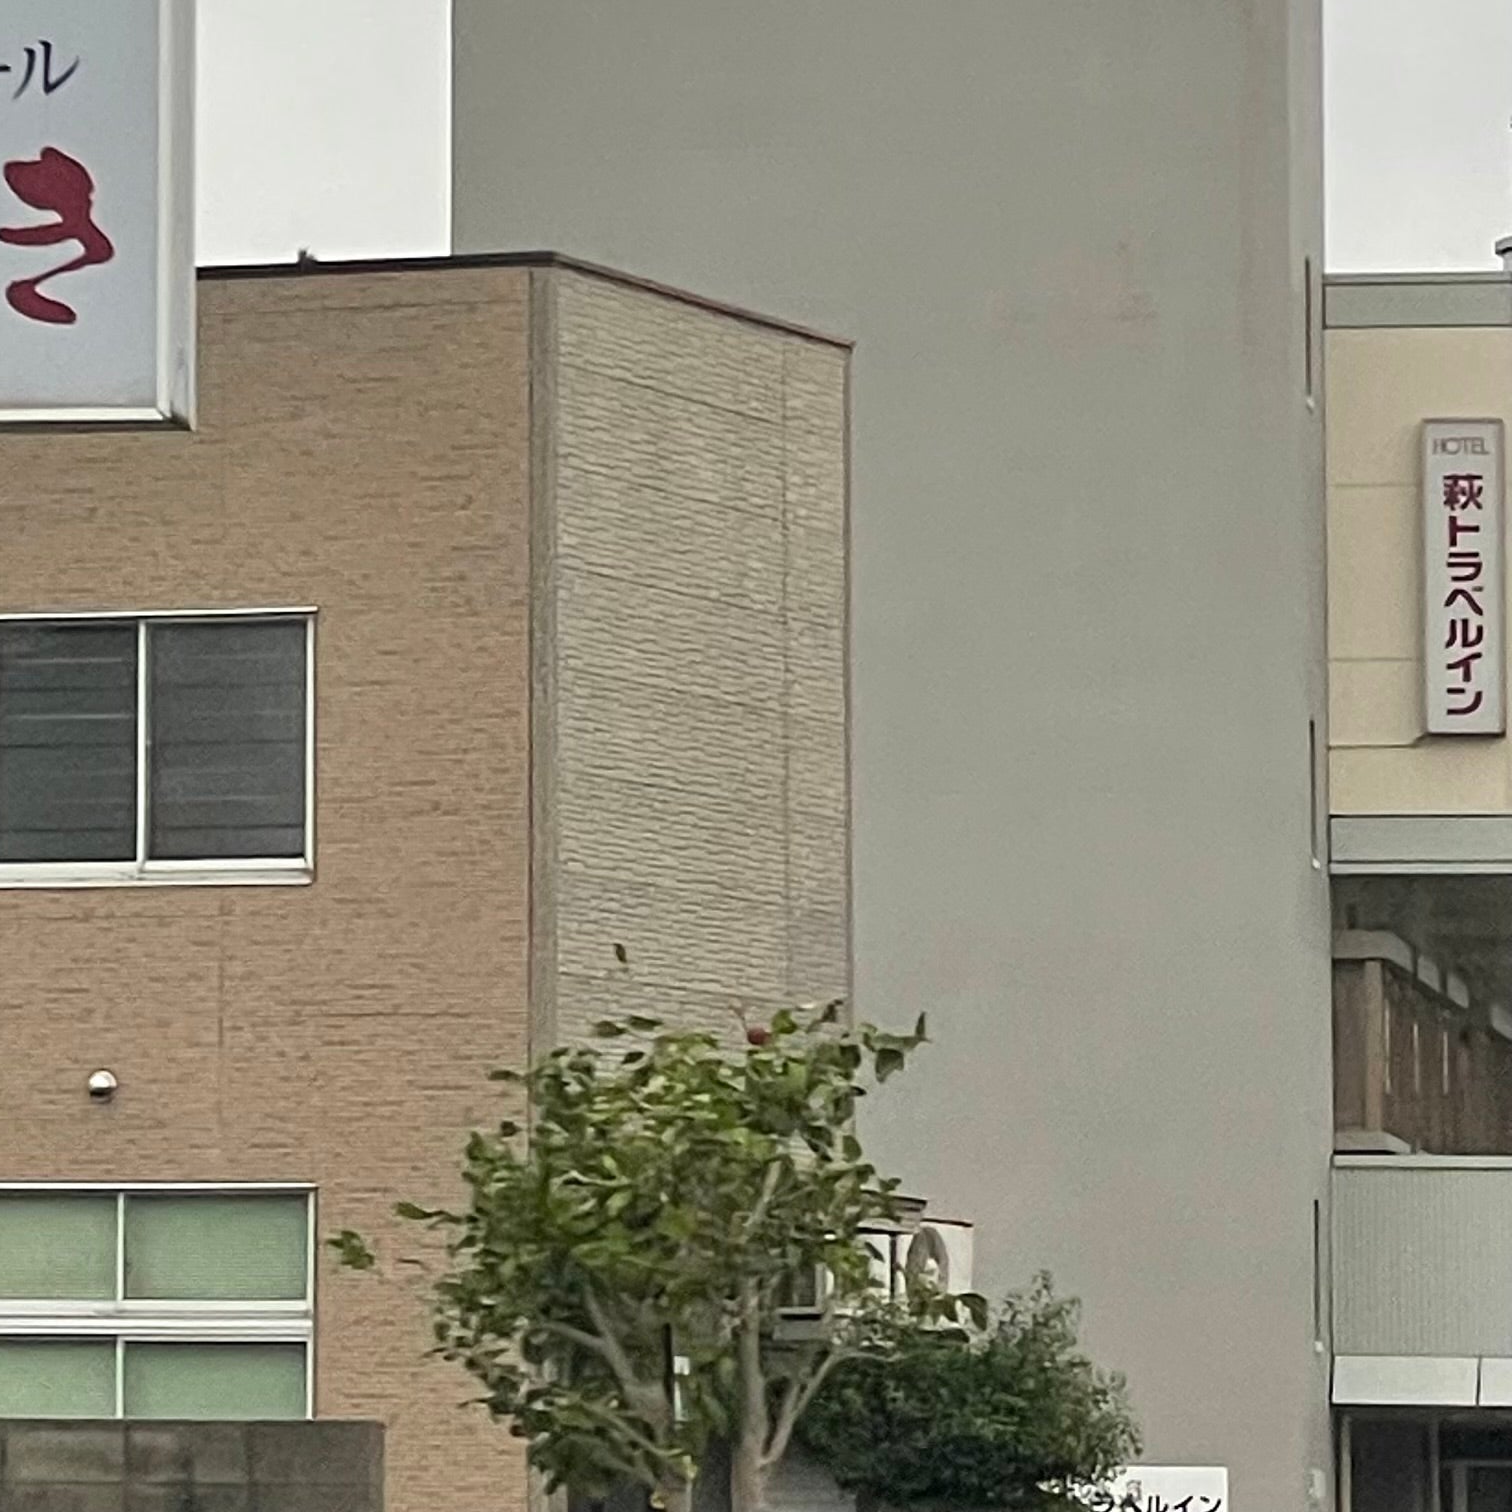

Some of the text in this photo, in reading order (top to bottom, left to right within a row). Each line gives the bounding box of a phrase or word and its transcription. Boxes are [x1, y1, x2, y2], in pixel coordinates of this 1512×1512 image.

[1431, 436, 1490, 455] HOTEL
[1442, 473, 1484, 716] 萩トラベルイン
